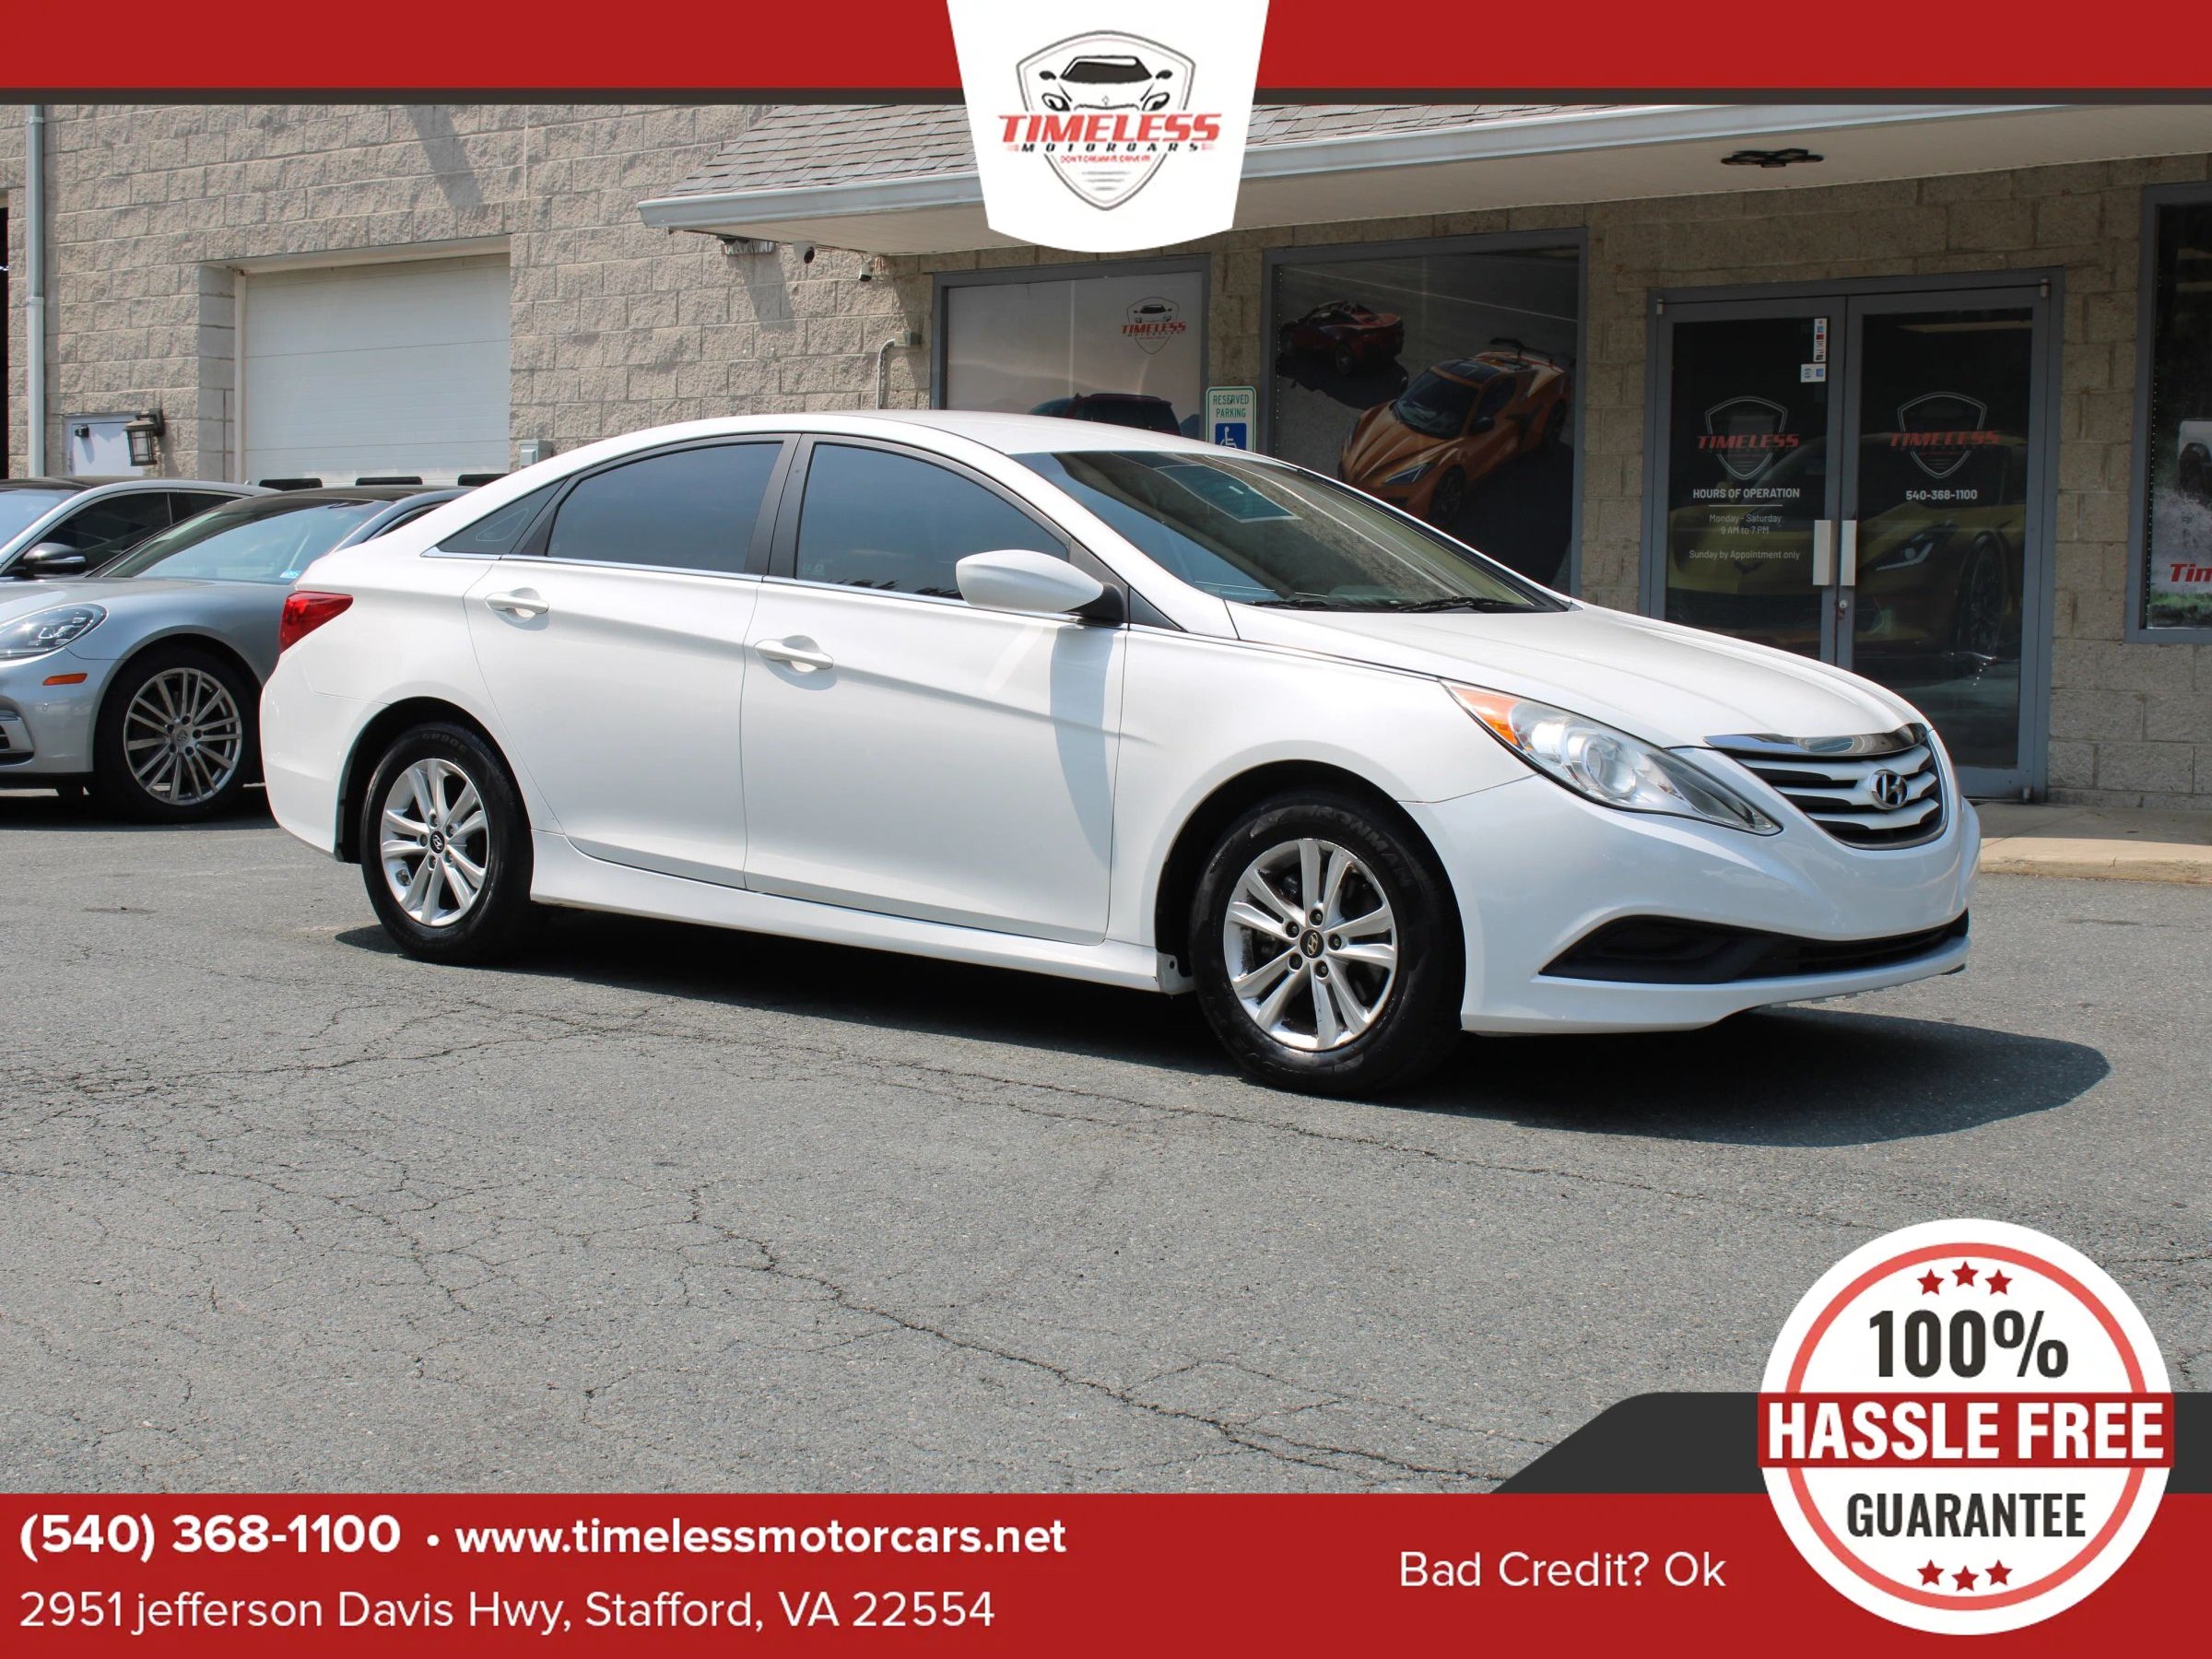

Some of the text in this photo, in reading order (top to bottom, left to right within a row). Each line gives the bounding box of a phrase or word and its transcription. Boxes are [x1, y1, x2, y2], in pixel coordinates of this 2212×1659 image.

[1121, 322, 1186, 334] TIMELESS
[1213, 394, 1249, 405] RESERVED
[1216, 408, 1246, 418] PARKING
[1698, 434, 1799, 449] TIMELESS
[1889, 430, 2002, 447] TIMELESS
[1693, 488, 1800, 499] HOURS OF OPERATION
[1906, 489, 1978, 500] 540-368-1100
[1709, 514, 1739, 524] Monday
[1746, 513, 1782, 524] Saturday
[1727, 525, 1739, 535] AM
[1741, 525, 1749, 535] to
[1751, 525, 1756, 534] 7
[1758, 525, 1770, 534] PM
[1689, 550, 1800, 560] Sunday by Appointment only
